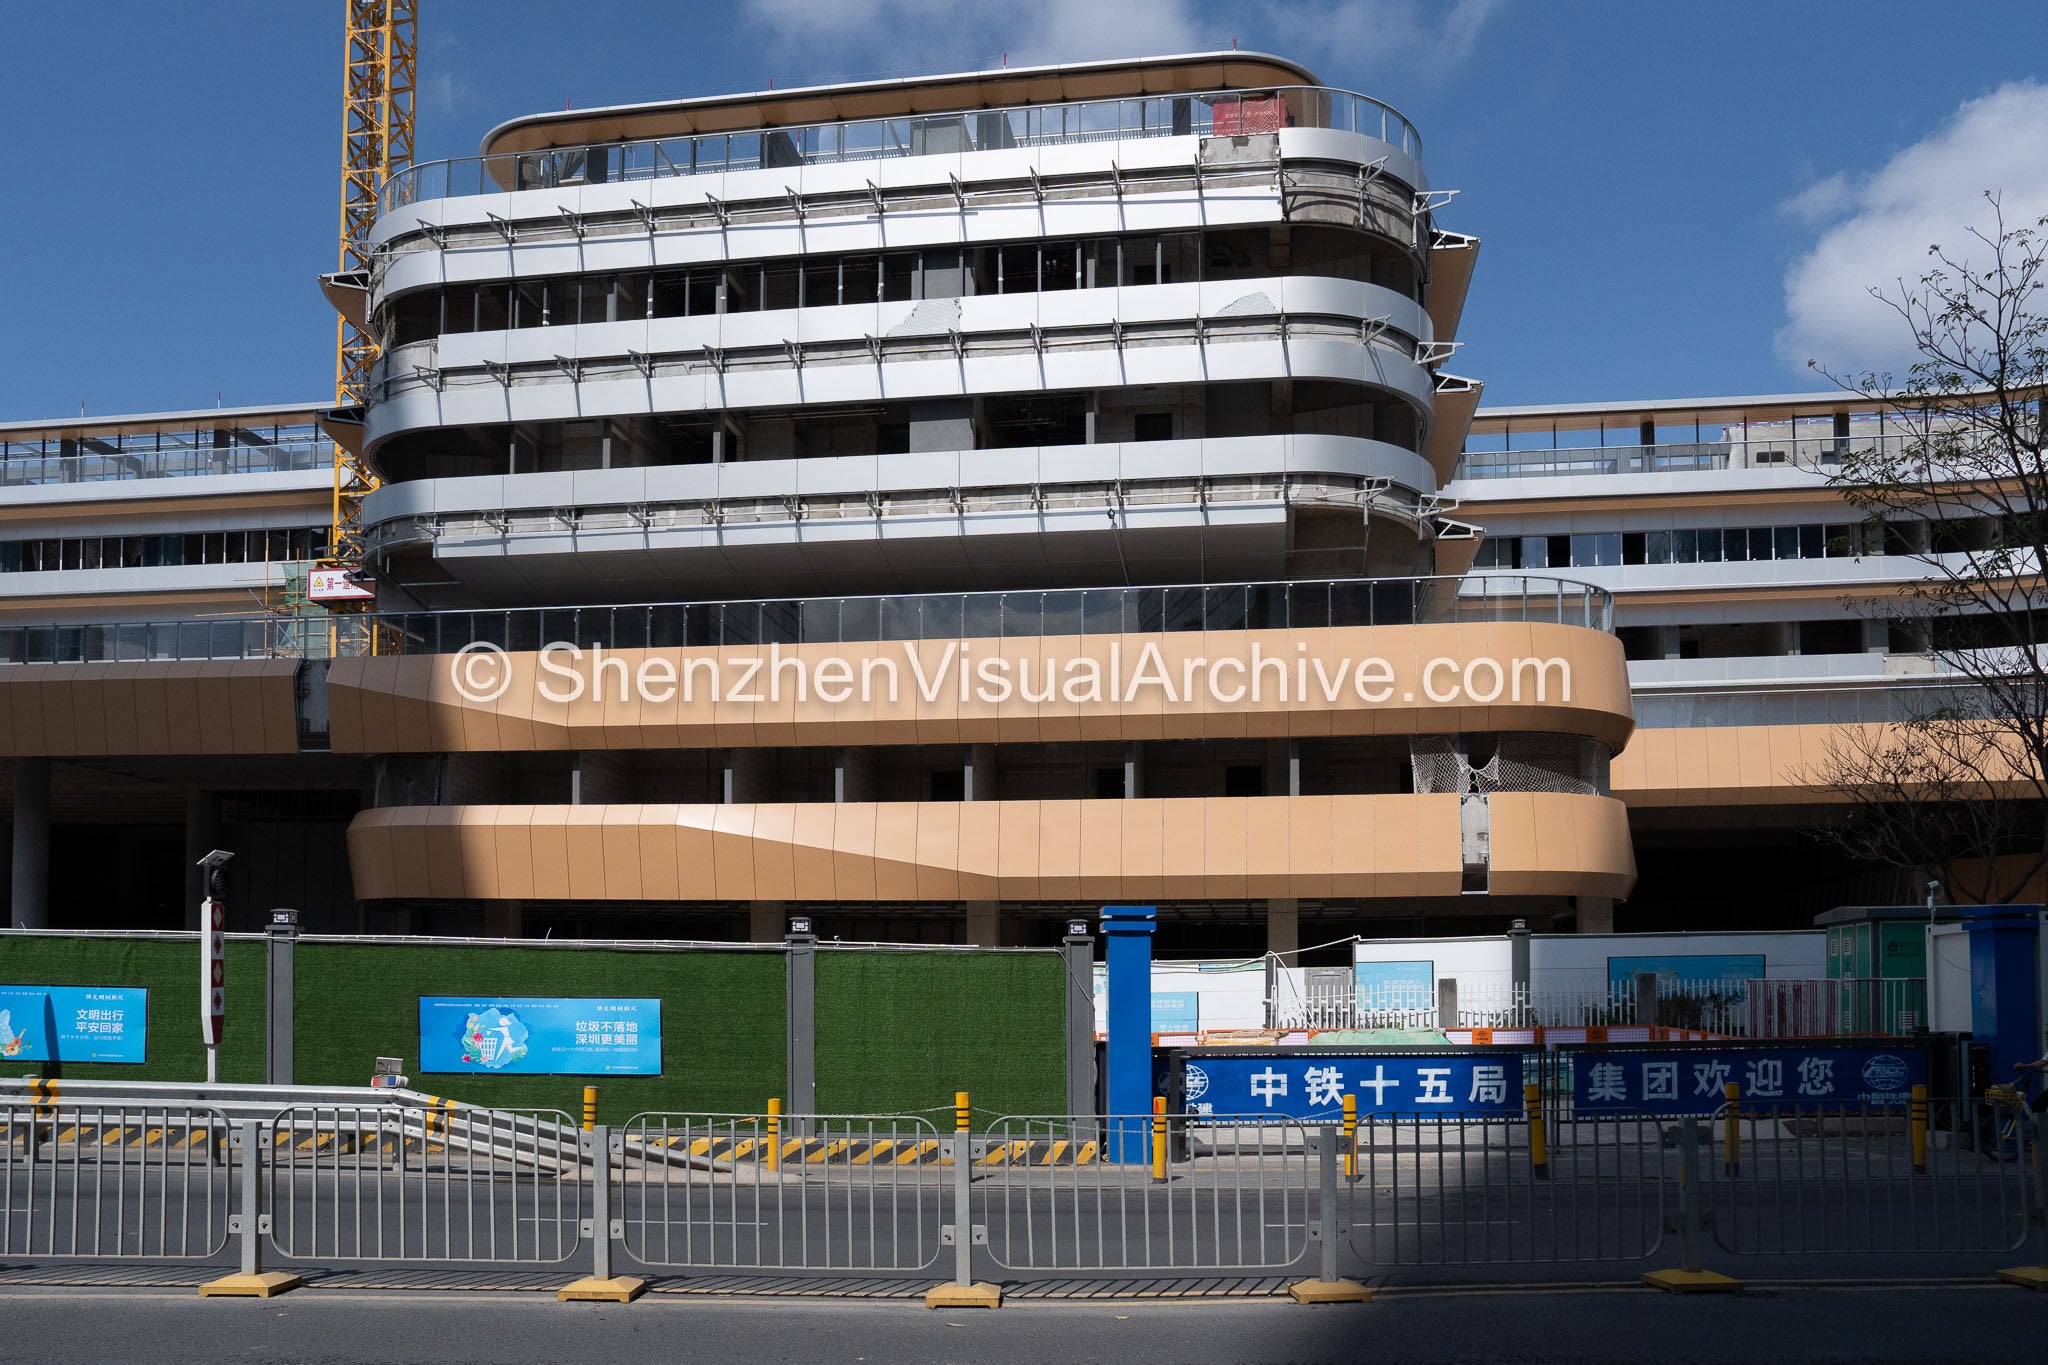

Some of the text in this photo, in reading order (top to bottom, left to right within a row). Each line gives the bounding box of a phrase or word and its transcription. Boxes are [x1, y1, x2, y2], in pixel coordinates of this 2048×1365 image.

[76, 1009, 124, 1021] 文明出行
[76, 1021, 124, 1034] 平安回家
[575, 1020, 638, 1032] 垃圾不落地
[575, 1033, 638, 1045] 深圳更美丽
[1588, 1056, 1835, 1101] 集团欢迎您
[1250, 1065, 1507, 1107] 中铁十五局
